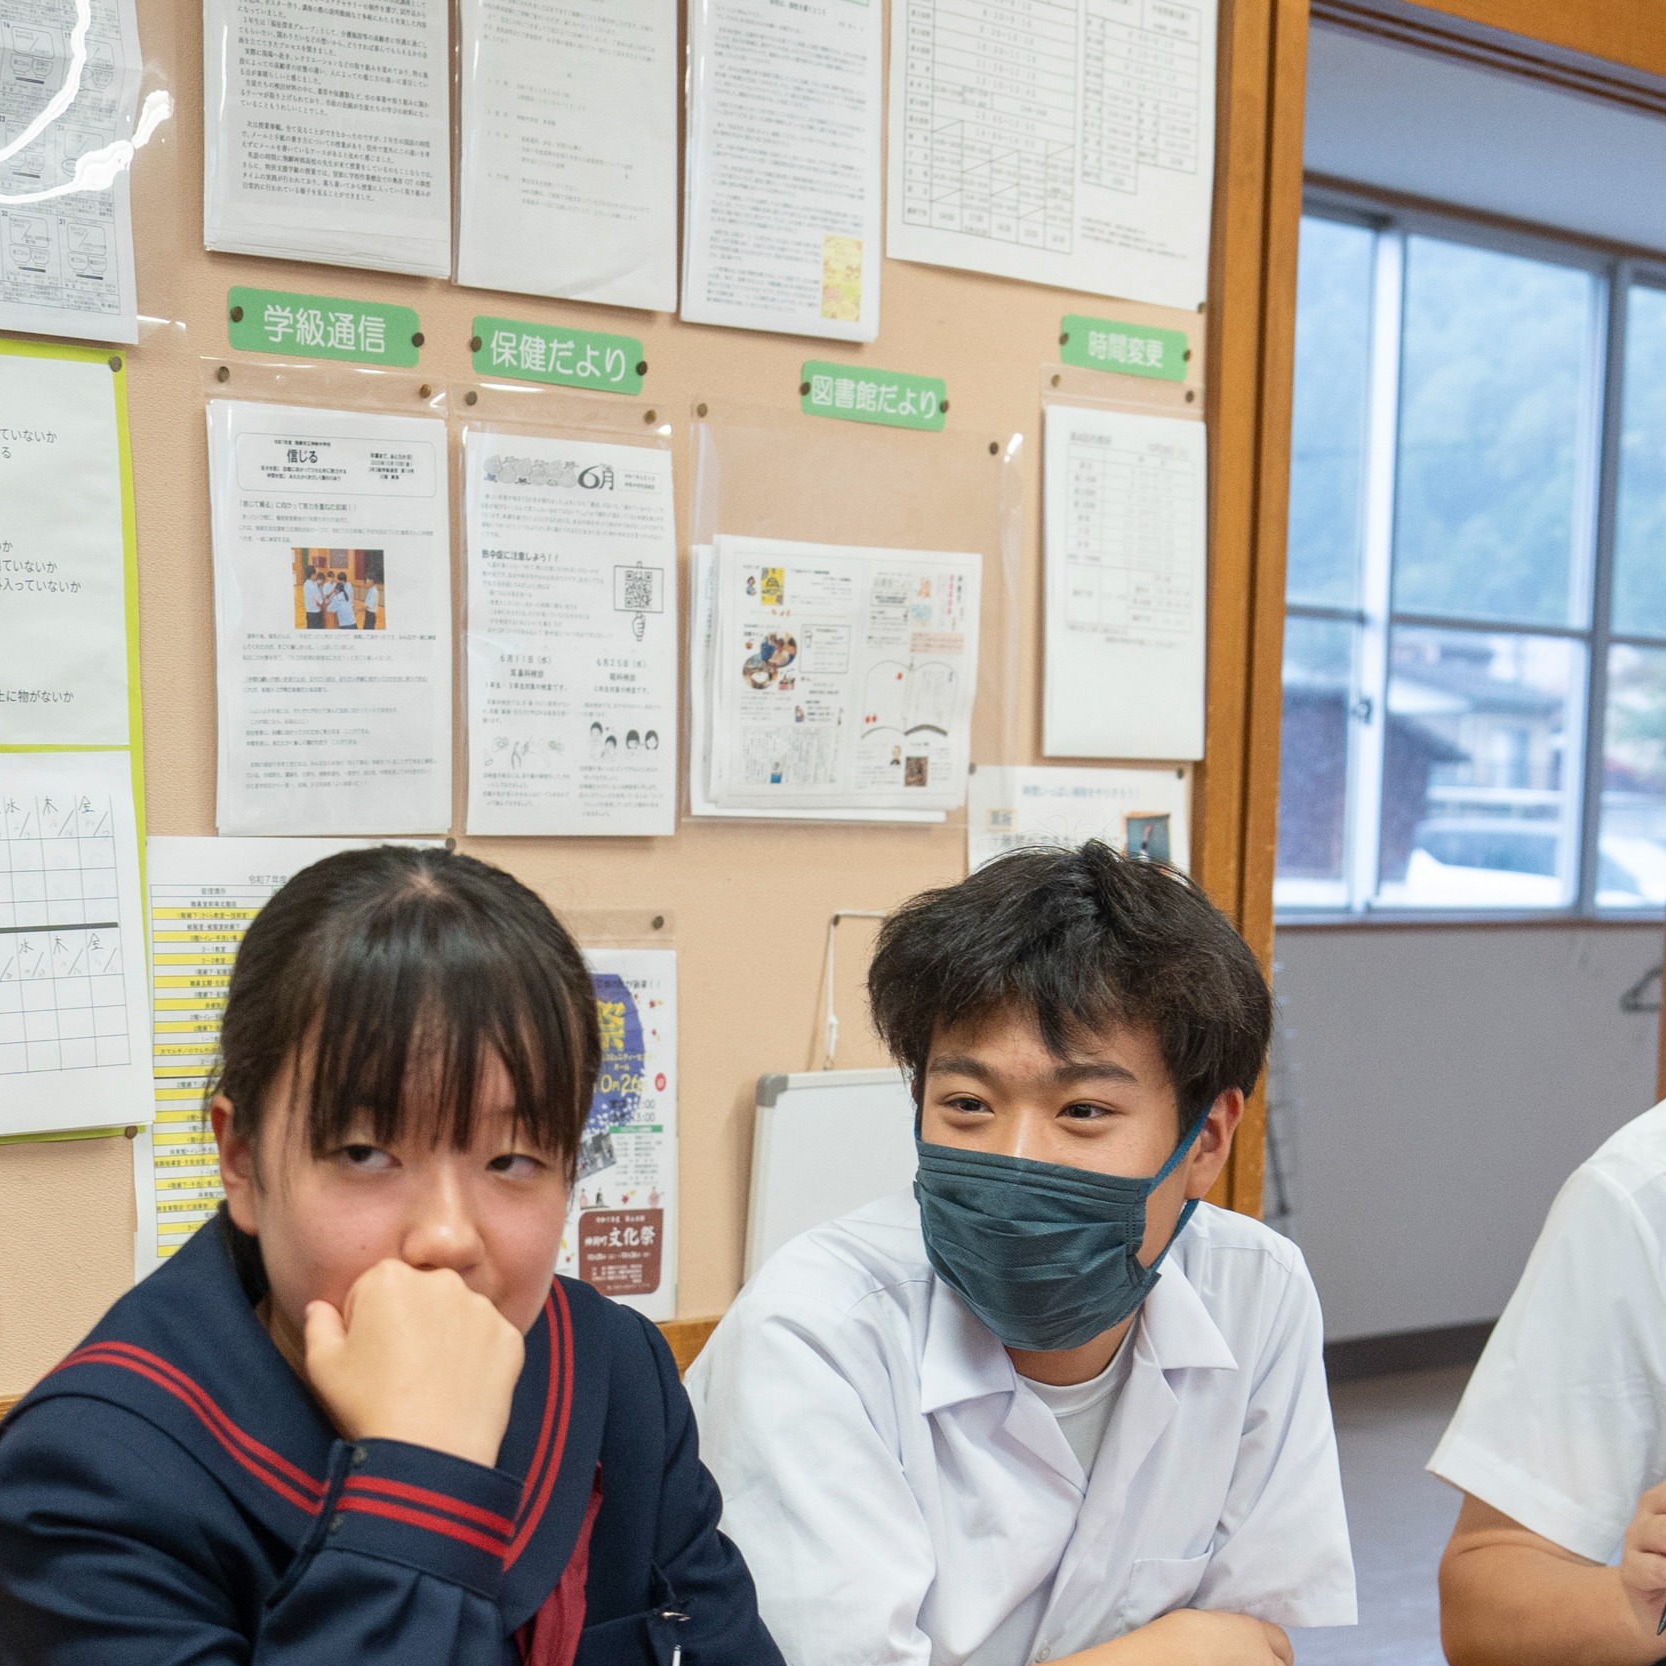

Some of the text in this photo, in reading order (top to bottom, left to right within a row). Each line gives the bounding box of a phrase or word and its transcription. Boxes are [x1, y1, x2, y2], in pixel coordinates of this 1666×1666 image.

[264, 304, 386, 354] 学級通信
[1087, 330, 1165, 368] 時間変更
[490, 330, 626, 382] 保健だより
[811, 374, 937, 419] 図書館だより
[287, 449, 318, 464] 信じる
[577, 464, 614, 490] 6月
